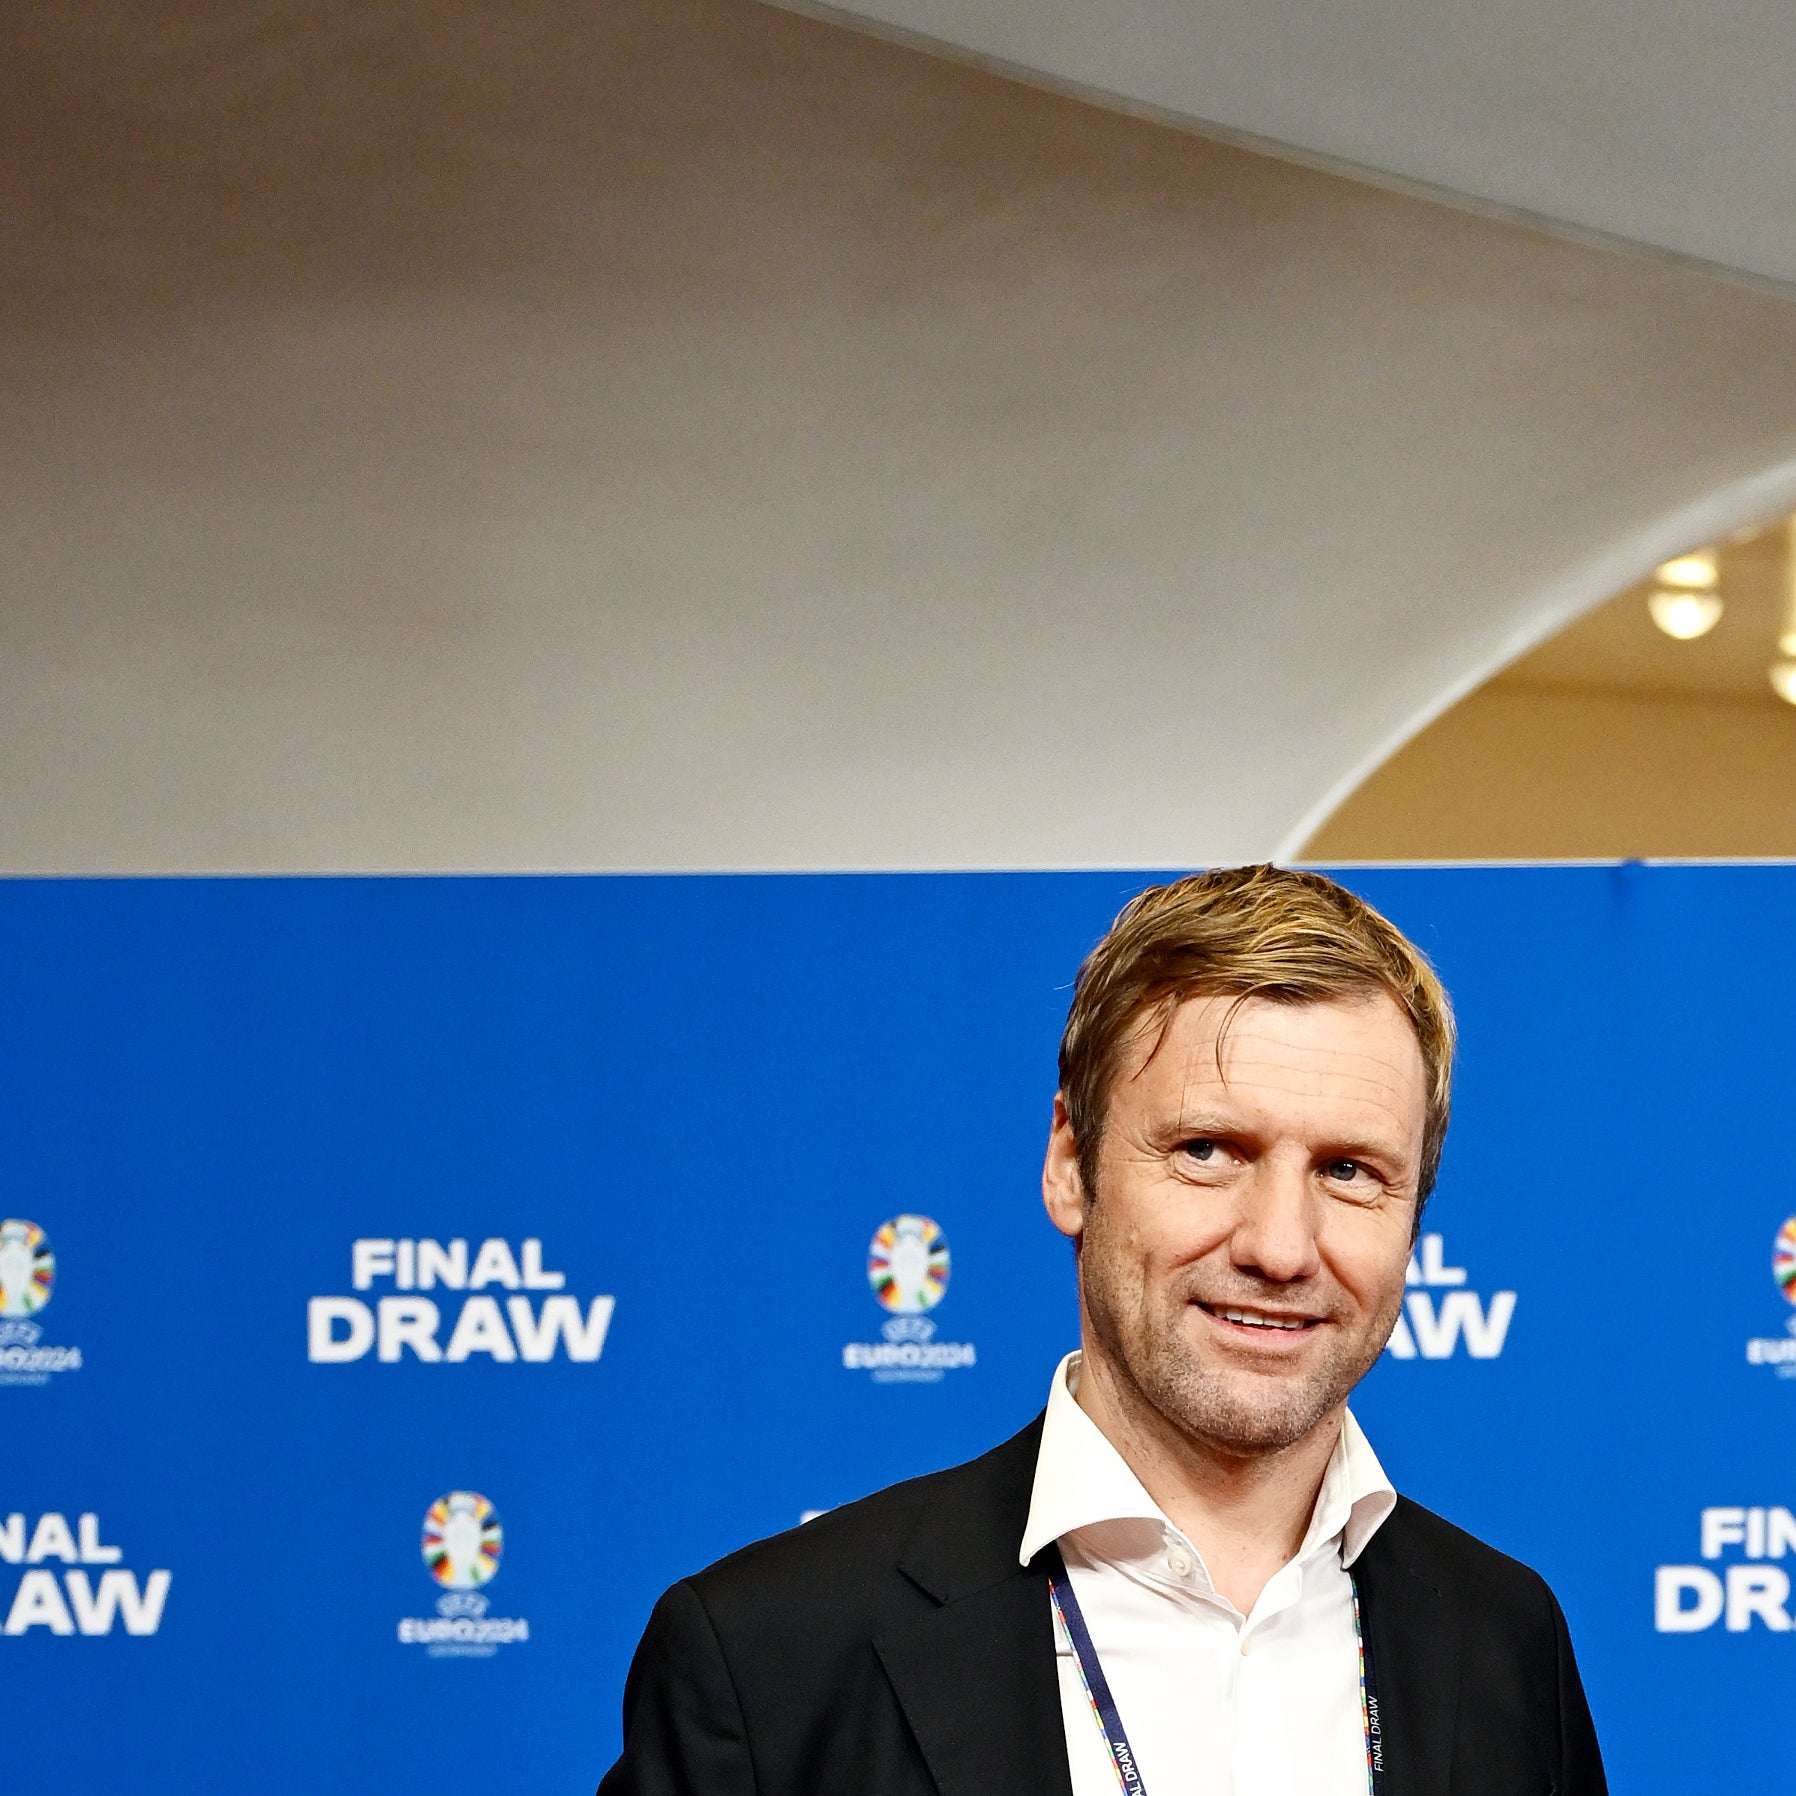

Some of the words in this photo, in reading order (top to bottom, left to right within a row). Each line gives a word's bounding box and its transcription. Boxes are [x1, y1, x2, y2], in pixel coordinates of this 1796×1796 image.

[352, 1238, 565, 1290] FINAL
[307, 1295, 615, 1363] DRAW
[843, 1342, 976, 1369] EURO2024
[0, 1569, 172, 1636] AW
[397, 1617, 529, 1644] EURO2024
[1369, 1695, 1383, 1735] DRAW
[1114, 1741, 1138, 1782] DRAW
[1374, 1736, 1385, 1773] FINAL
